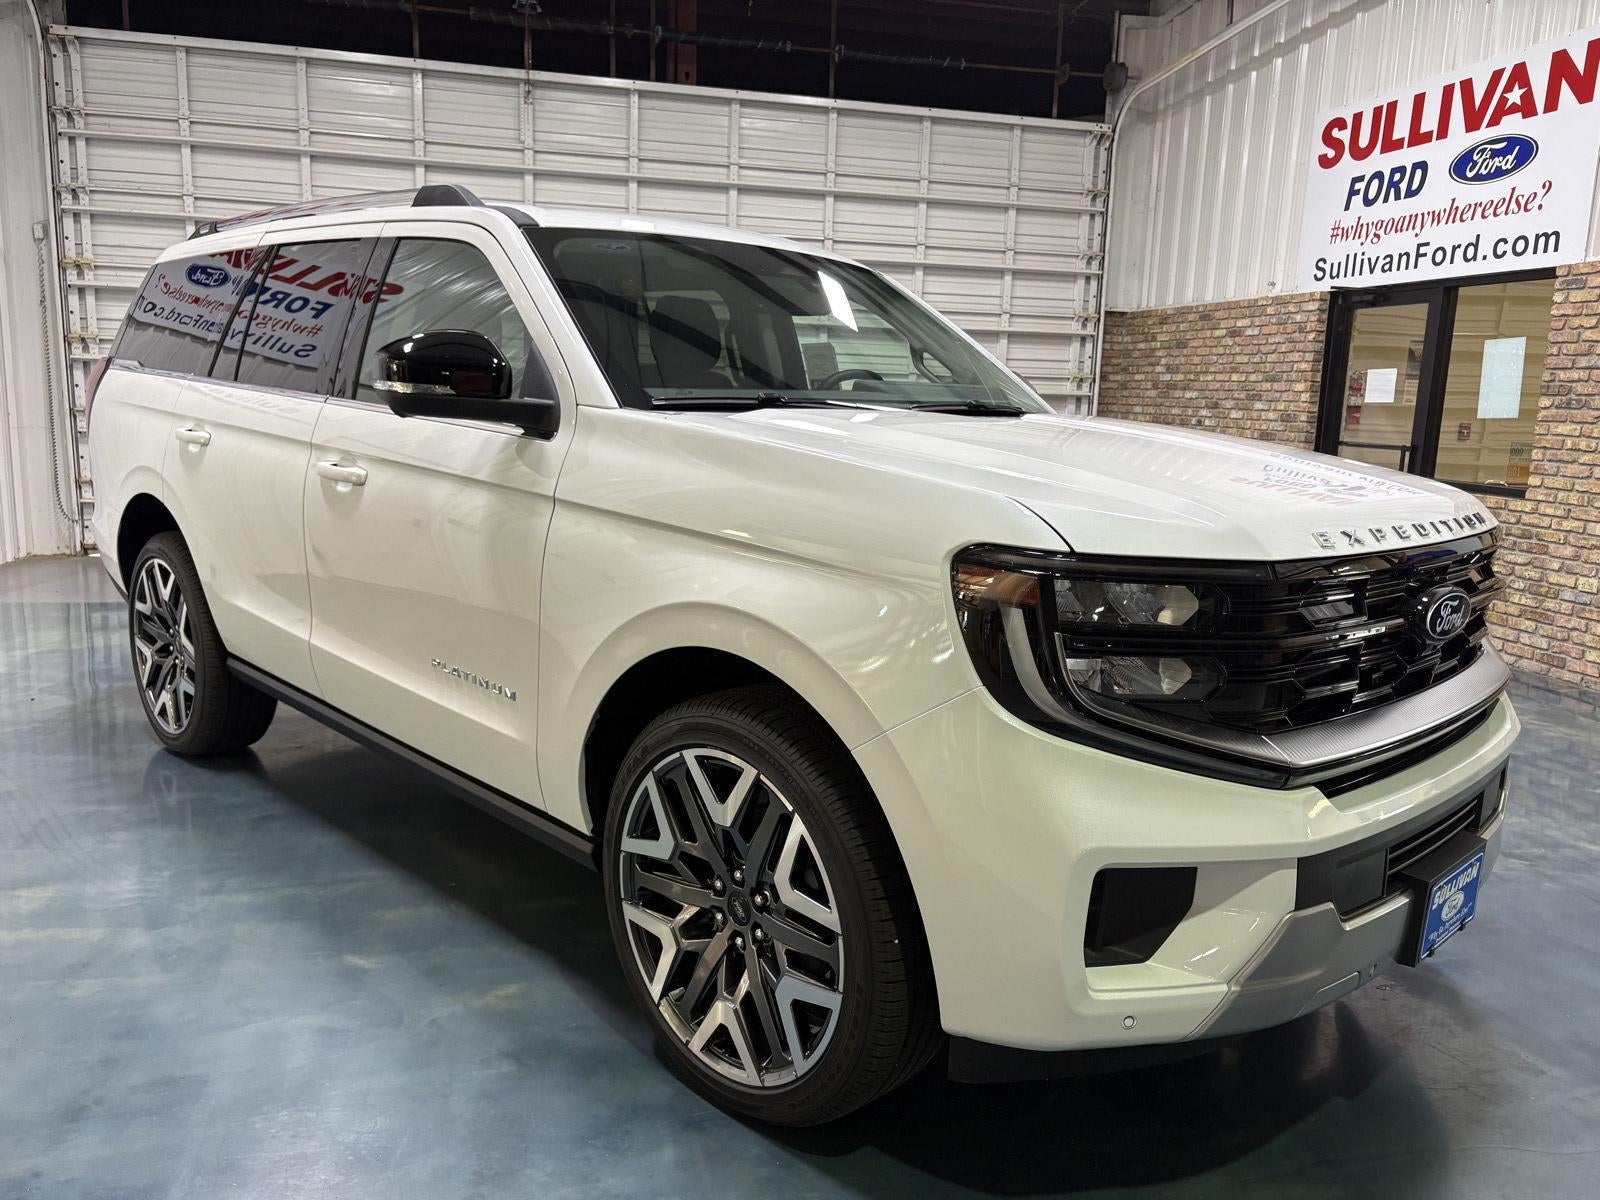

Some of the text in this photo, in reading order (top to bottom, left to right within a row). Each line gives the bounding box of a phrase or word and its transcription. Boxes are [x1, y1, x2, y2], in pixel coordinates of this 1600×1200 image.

[1318, 37, 1600, 170] SULLIVAN
[1344, 160, 1429, 212] FORD
[1329, 180, 1553, 246] #whygoanywhereelse?
[1313, 229, 1561, 282] SullivanFord.com
[1311, 511, 1488, 550] EXPEDITION
[1435, 601, 1466, 634] Ford
[431, 658, 516, 702] PLATINUM
[1432, 861, 1481, 911] SULLIVAN
